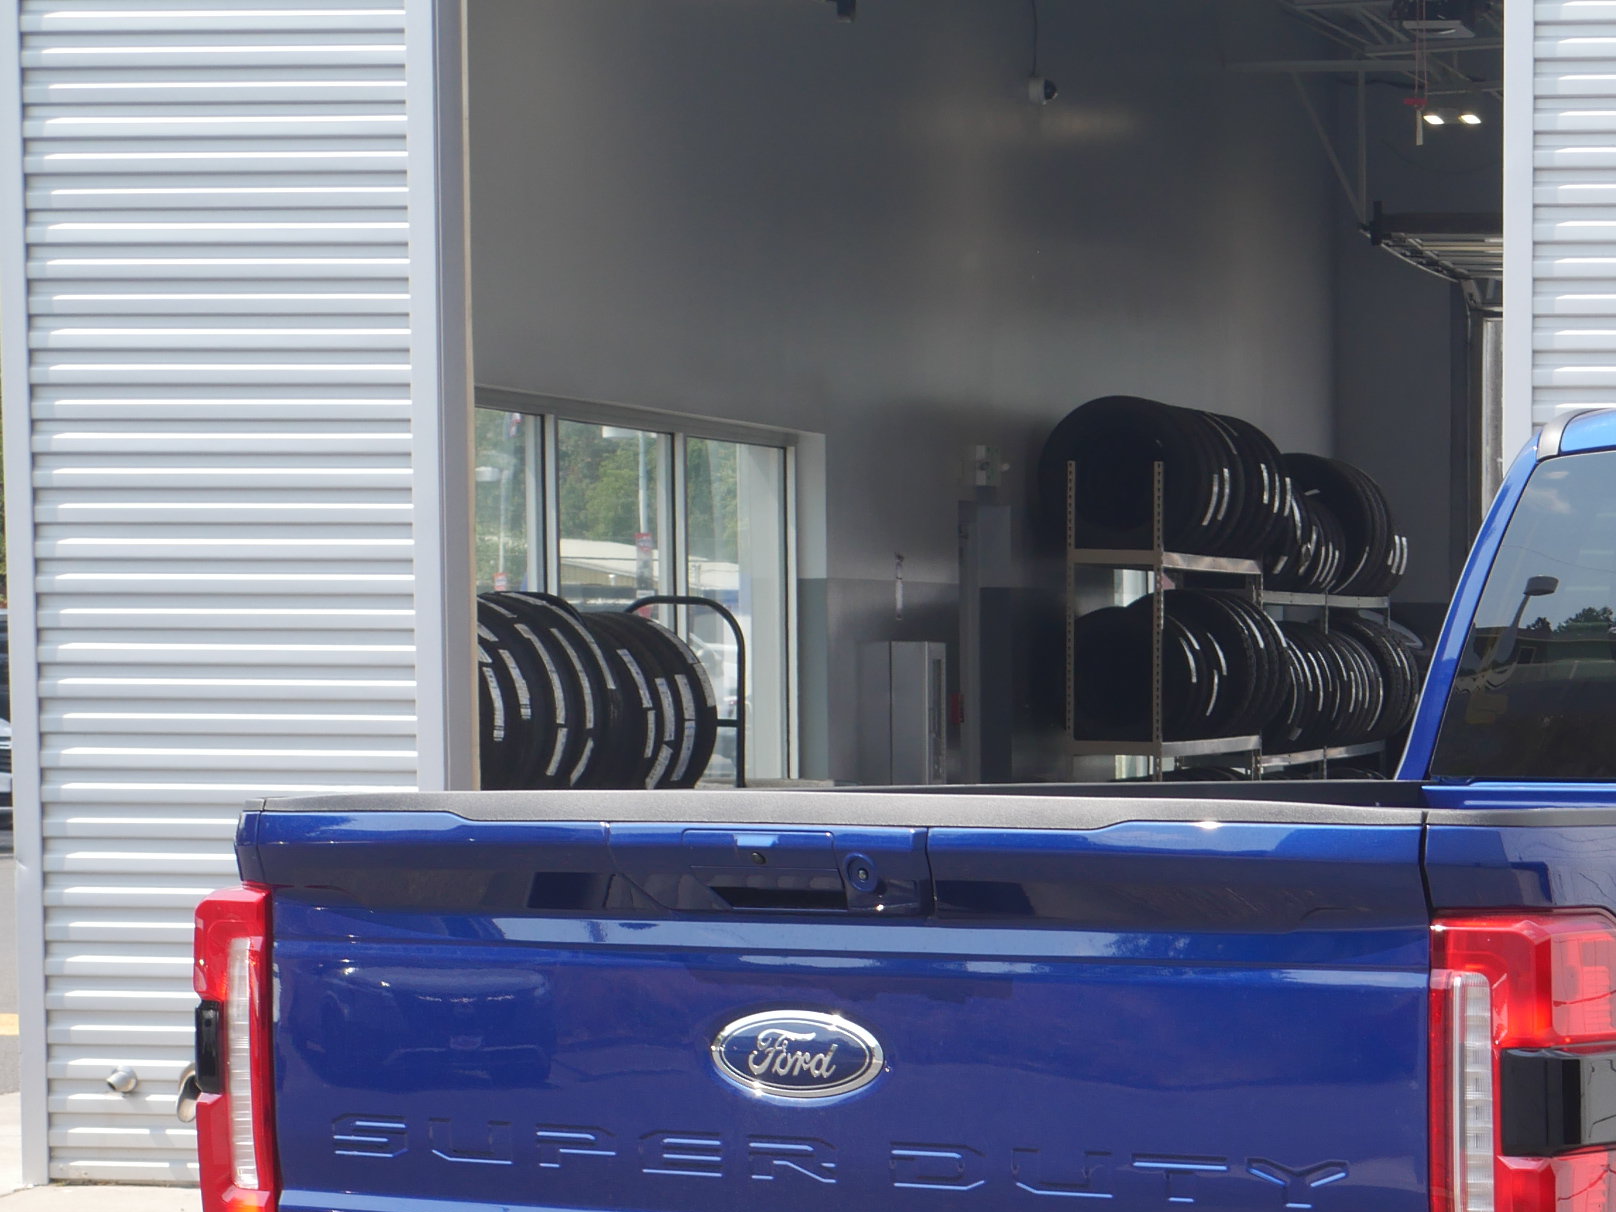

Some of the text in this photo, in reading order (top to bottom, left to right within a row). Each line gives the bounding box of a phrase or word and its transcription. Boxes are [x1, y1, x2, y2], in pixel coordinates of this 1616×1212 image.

[748, 1028, 838, 1079] Ford
[331, 1112, 1350, 1209] SUPER DUTY
